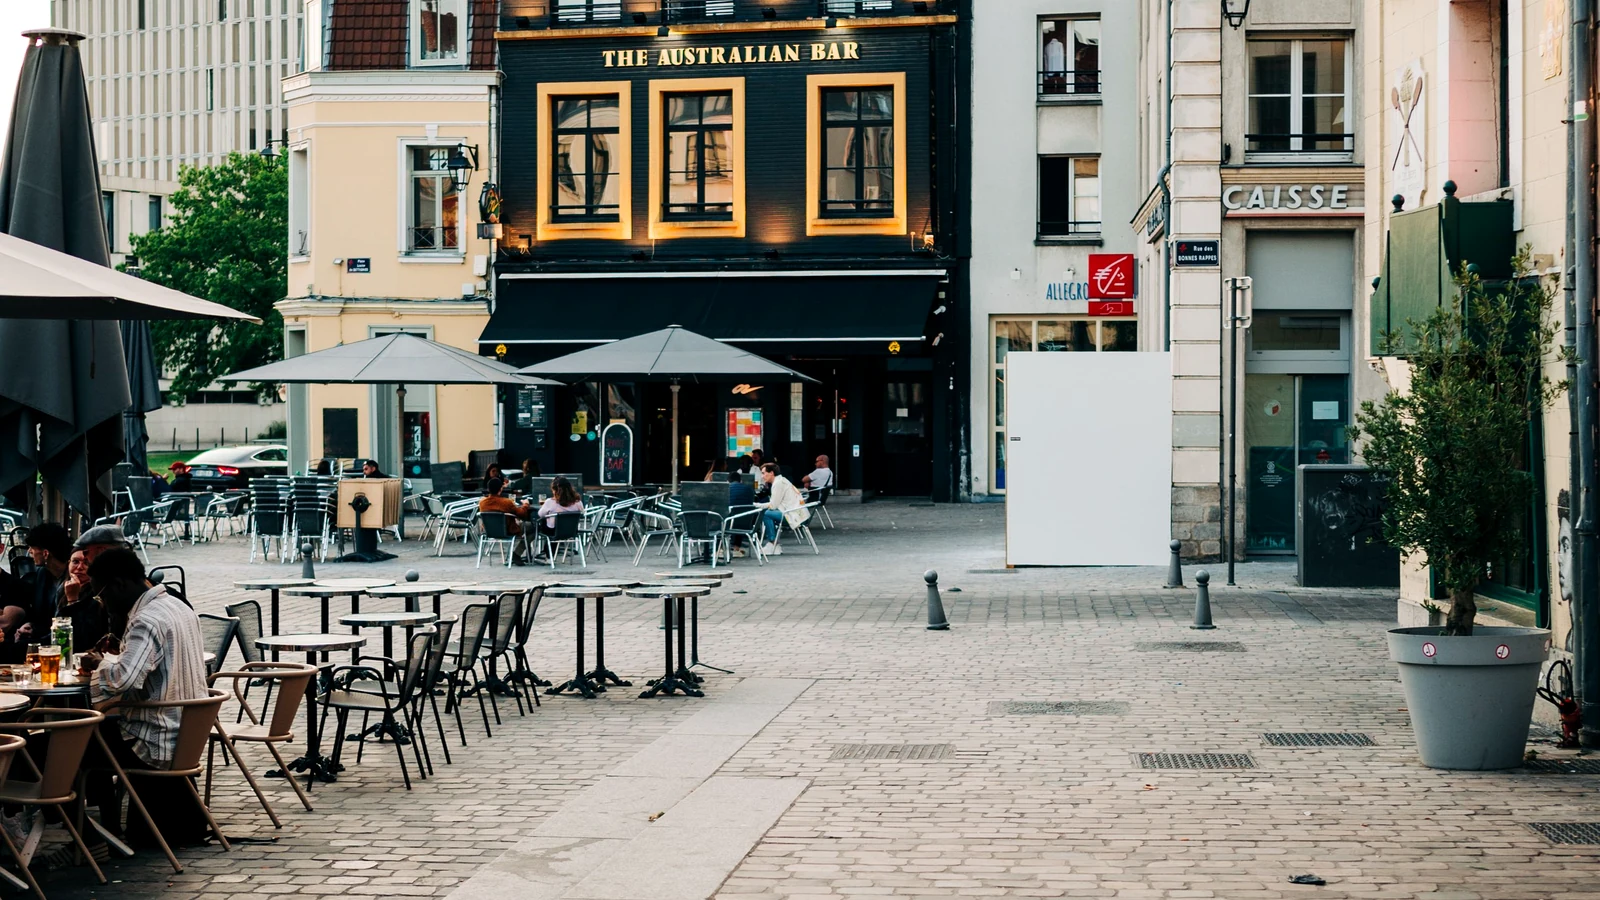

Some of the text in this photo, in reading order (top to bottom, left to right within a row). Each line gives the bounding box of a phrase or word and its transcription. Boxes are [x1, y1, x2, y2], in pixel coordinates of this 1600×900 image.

[602, 41, 860, 67] THE AUSTRALIAN BAR
[1222, 184, 1349, 210] CAISSE
[1046, 282, 1089, 301] ALLEGRO
[607, 458, 624, 471] BAR
